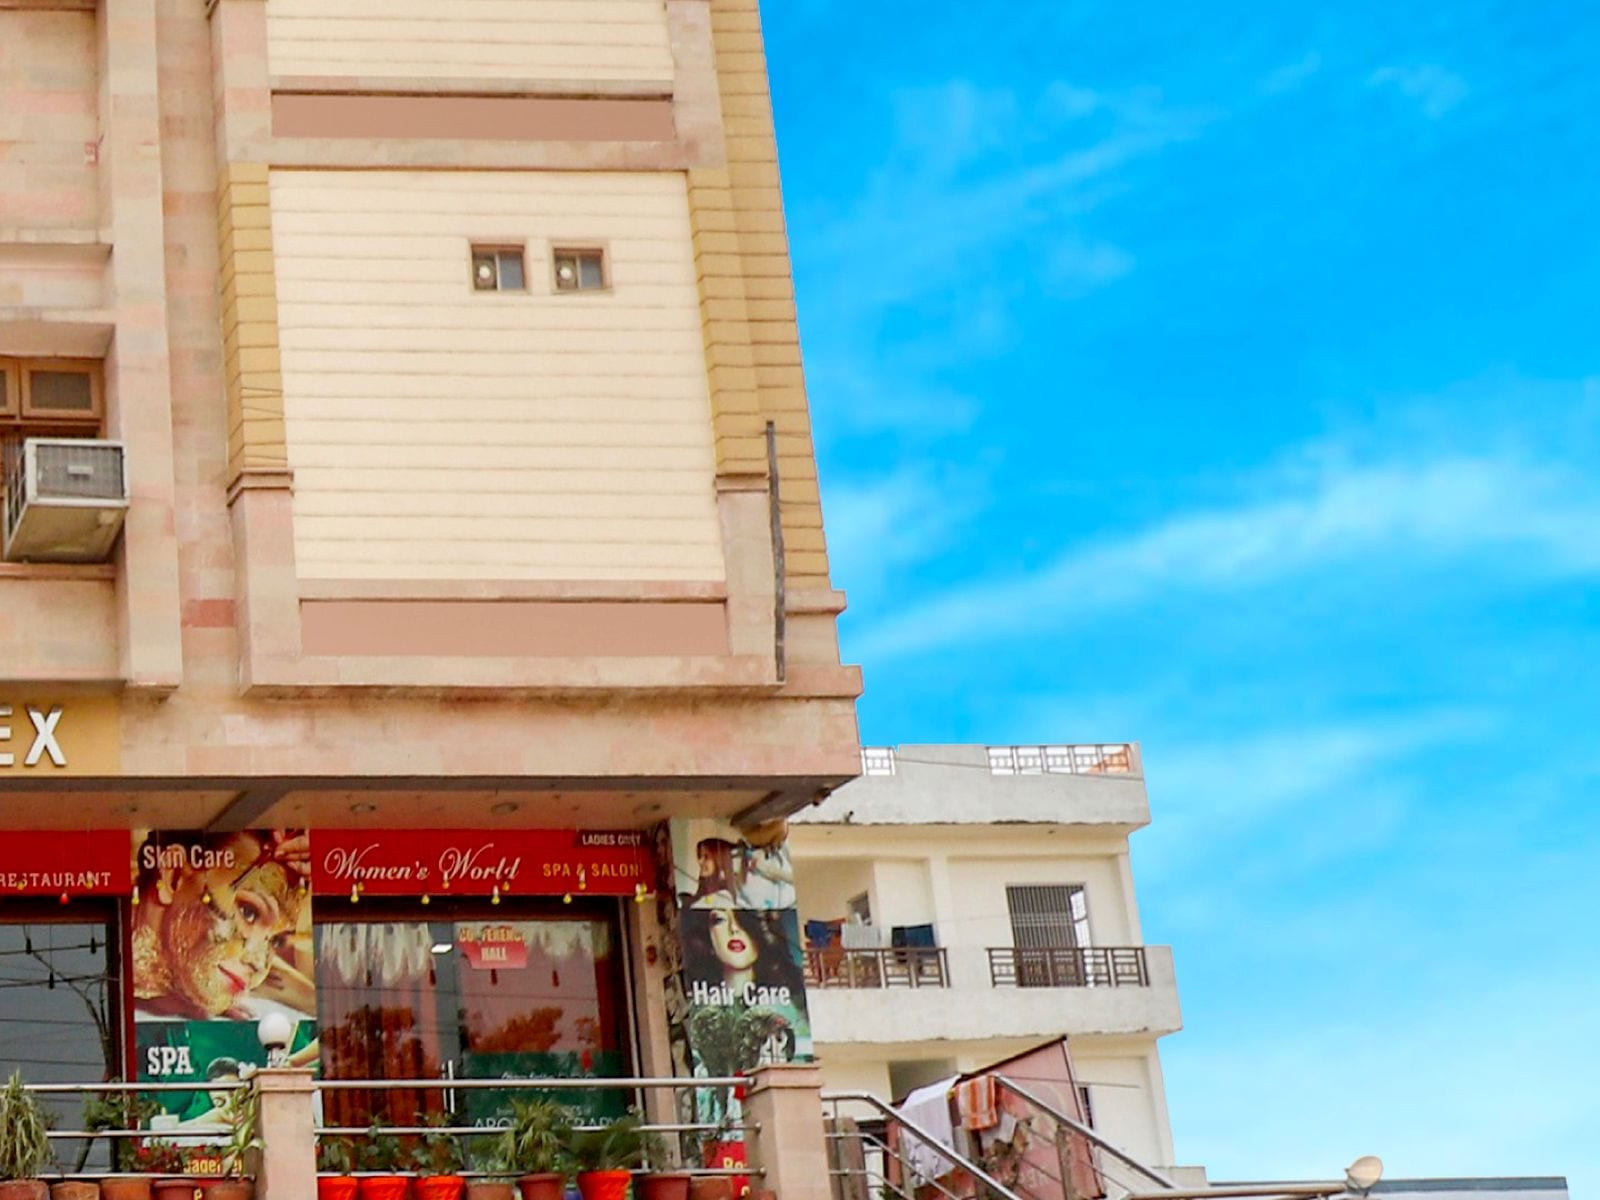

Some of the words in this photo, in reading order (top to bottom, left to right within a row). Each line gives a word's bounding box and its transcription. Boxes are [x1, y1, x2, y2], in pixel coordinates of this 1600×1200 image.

[582, 834, 615, 846] LADIES
[143, 844, 184, 869] Skin
[191, 845, 235, 869] Care
[324, 843, 430, 880] Women's
[438, 843, 521, 880] World
[542, 863, 571, 877] SPA
[591, 863, 639, 877] SALON
[693, 980, 735, 1006] Hair
[742, 981, 790, 1006] Care
[147, 1045, 194, 1075] SPA
